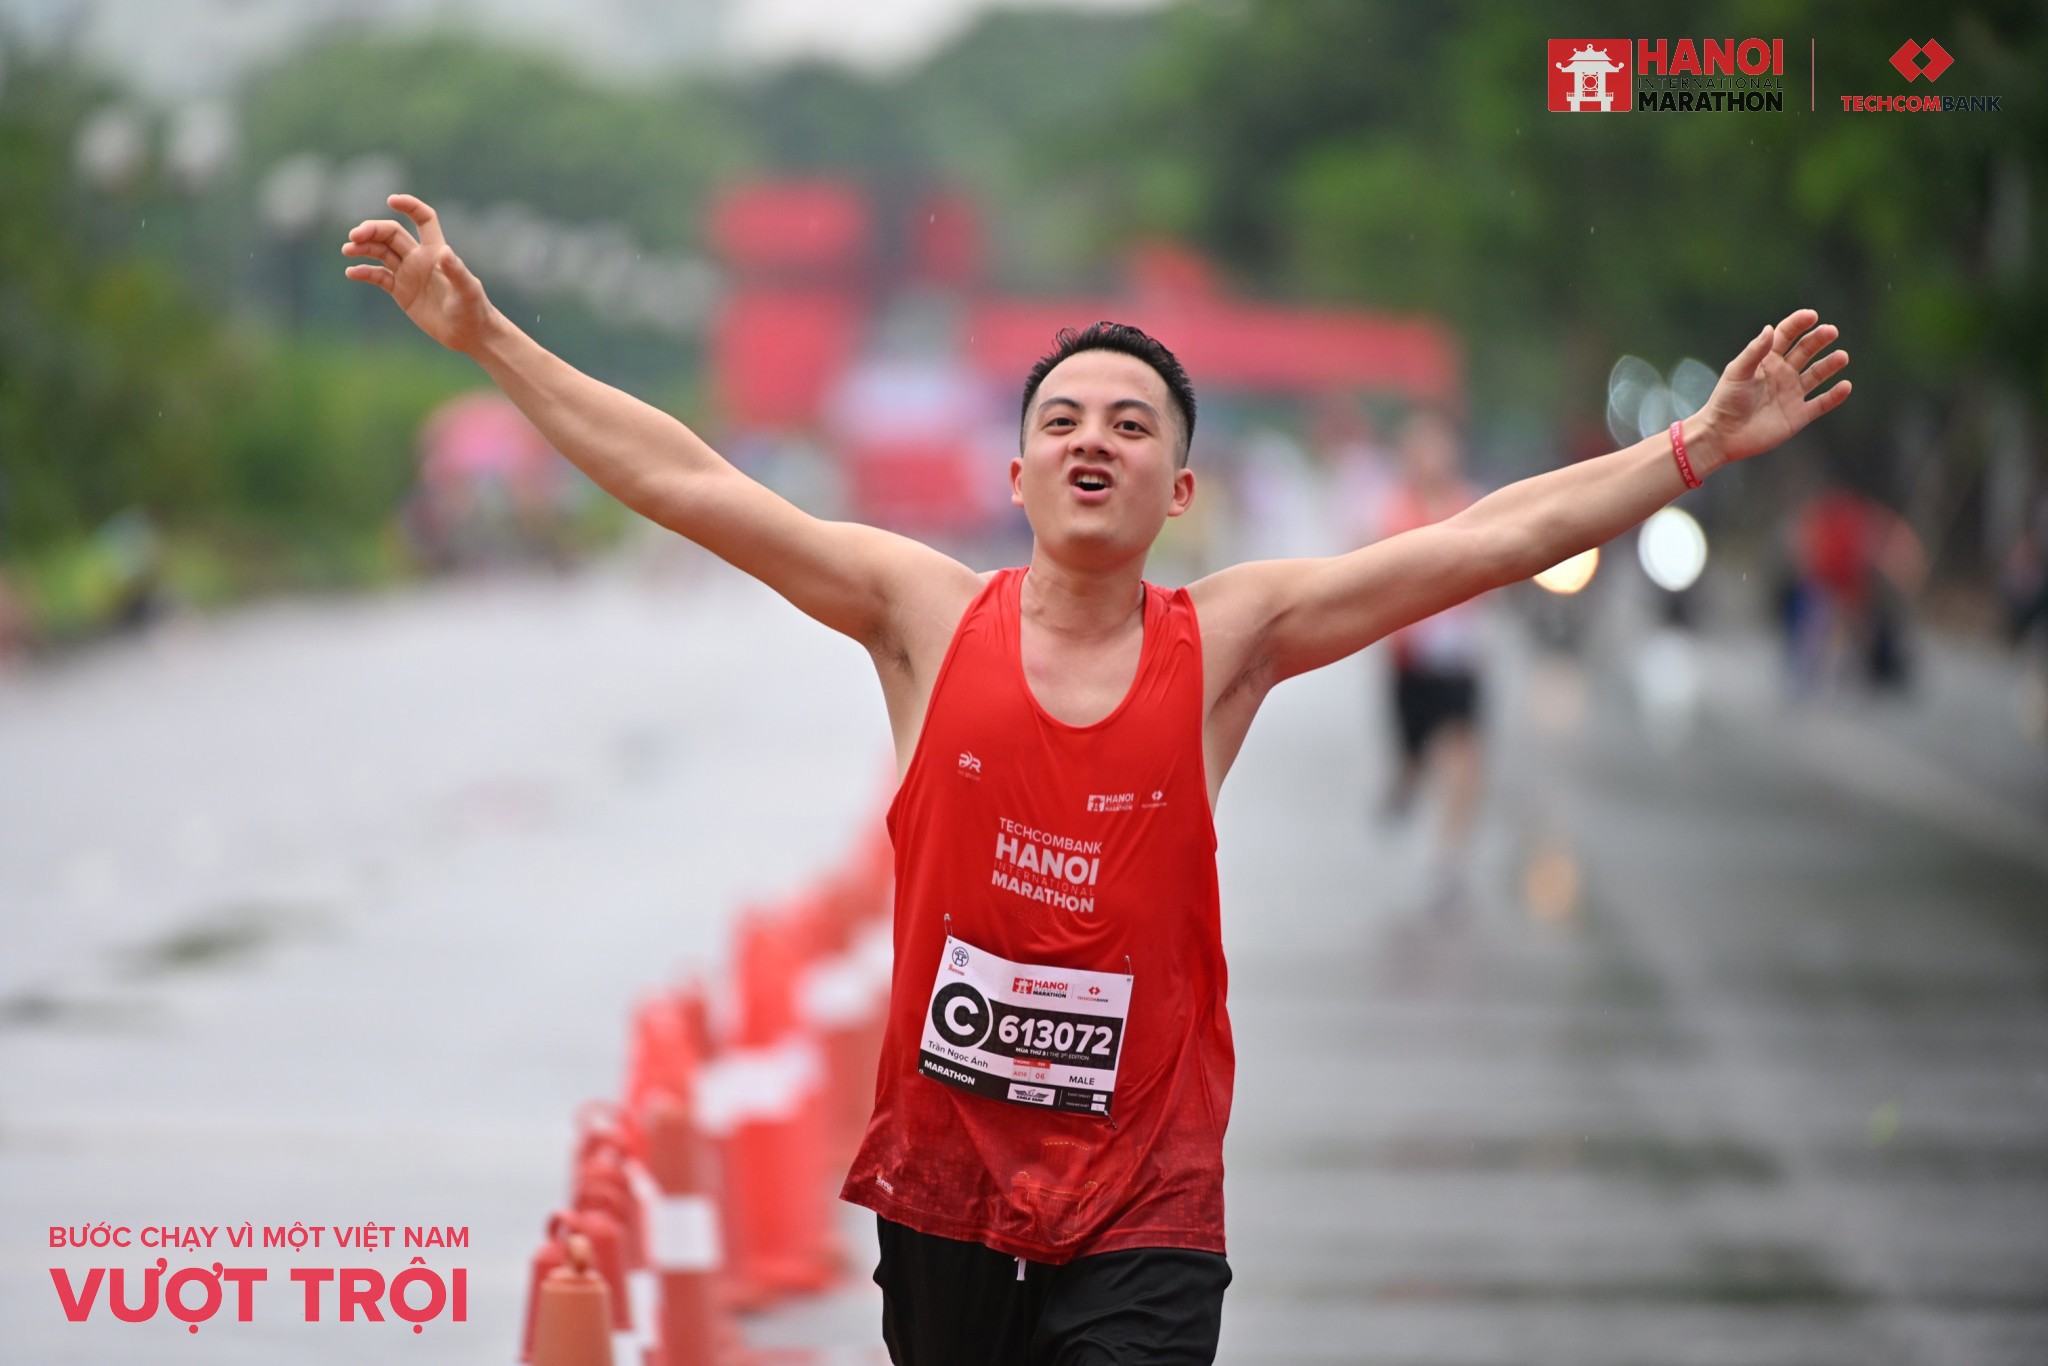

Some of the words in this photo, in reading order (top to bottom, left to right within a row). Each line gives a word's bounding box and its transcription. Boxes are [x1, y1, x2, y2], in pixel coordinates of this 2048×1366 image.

[1105, 793, 1134, 804] HANOI
[999, 816, 1102, 855] TECHCOMBANK
[995, 832, 1100, 886] HANOI
[991, 869, 1095, 913] MARATHON
[994, 860, 1095, 897] INTERNATIONAL
[1032, 990, 1067, 998] MARATHON
[1034, 979, 1068, 991] HANOI
[944, 996, 979, 1036] C
[928, 1040, 946, 1054] Trần
[947, 1048, 969, 1061] Ngọc
[998, 1014, 1113, 1056] 613072
[924, 1060, 976, 1086] MARATHON
[1068, 1075, 1095, 1086] MALE
